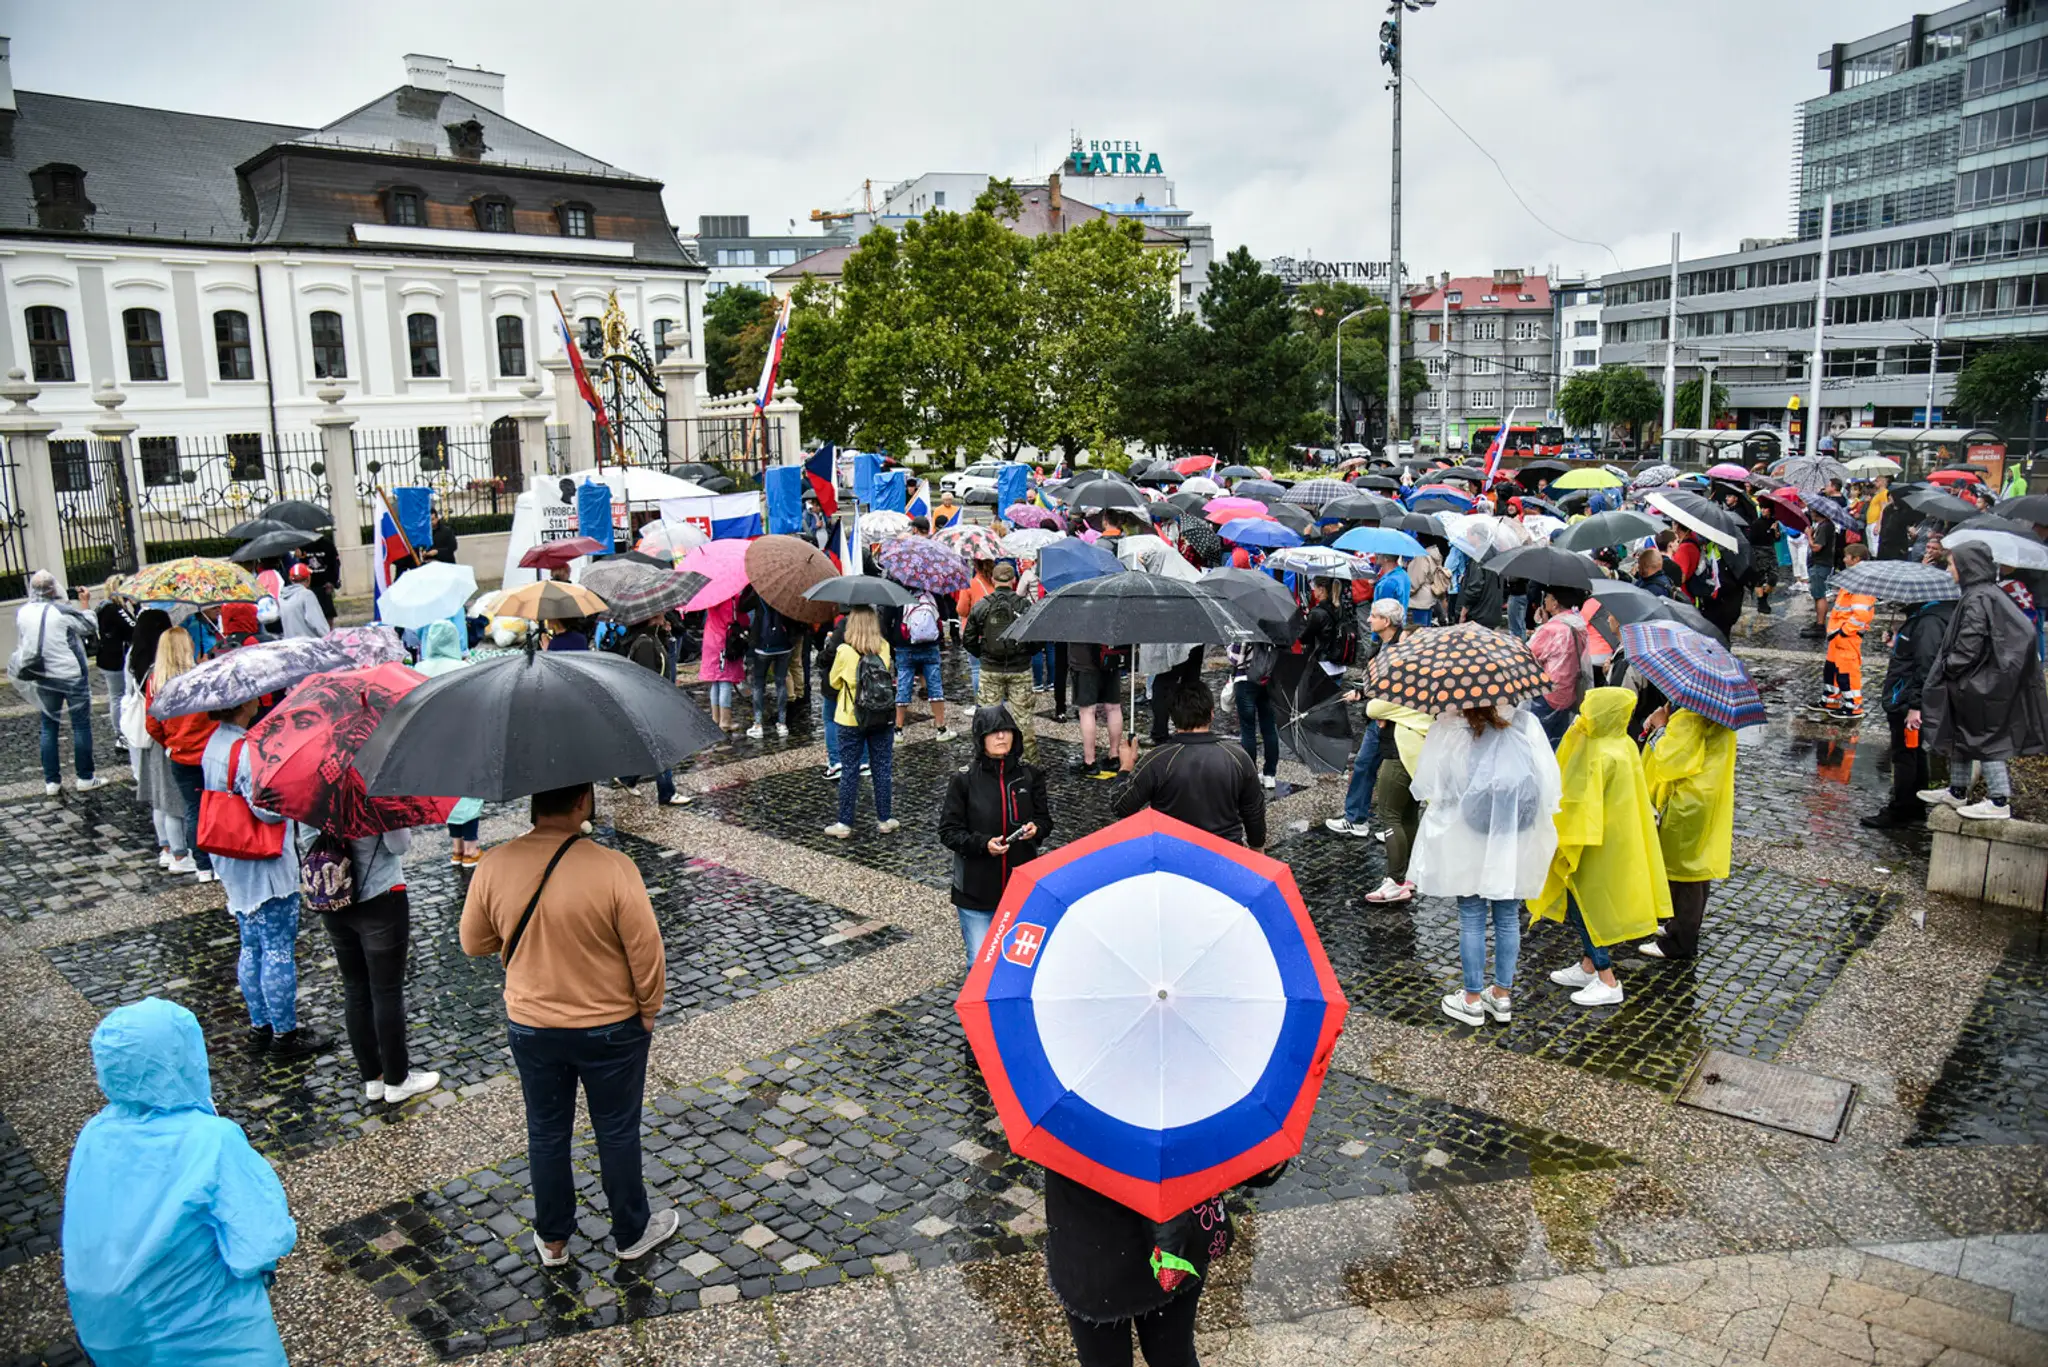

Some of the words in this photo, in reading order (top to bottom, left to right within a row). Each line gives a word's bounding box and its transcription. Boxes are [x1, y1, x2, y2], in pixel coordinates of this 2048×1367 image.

[1090, 140, 1142, 151] HOTEL
[1070, 152, 1164, 174] TATRA
[984, 911, 1010, 963] SLOVAKIA
